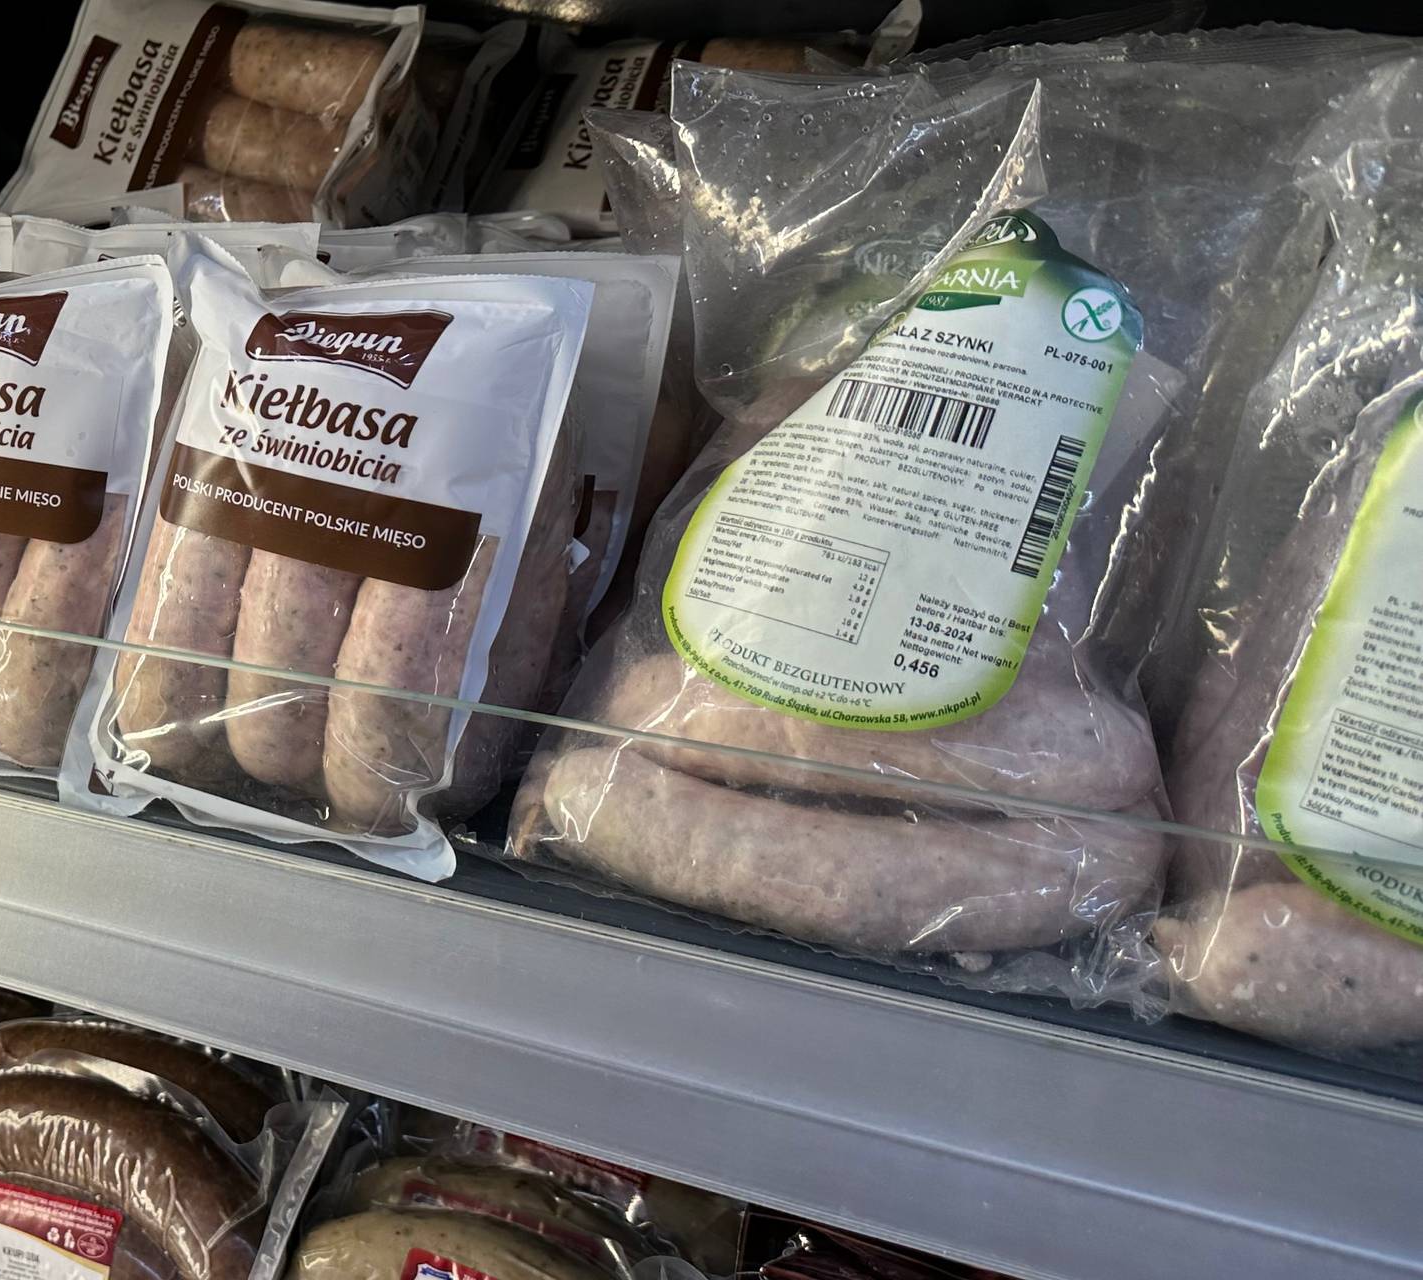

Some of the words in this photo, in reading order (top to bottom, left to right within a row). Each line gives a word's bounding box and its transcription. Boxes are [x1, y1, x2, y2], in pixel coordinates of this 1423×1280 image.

[93, 39, 163, 165] Kiełbasa
[121, 141, 137, 163] ze
[131, 44, 179, 139] świniobicia
[939, 266, 1023, 291] ARNIA
[920, 328, 931, 341] Z
[934, 331, 995, 354] SZYNKI
[1044, 345, 1115, 375] PL-075-001
[901, 359, 950, 377] OCHRONNEJ
[954, 367, 996, 386] PRODUCT
[995, 378, 1032, 396] PACKED
[1049, 394, 1104, 416] PROTECTIVE
[997, 388, 1044, 408] VERPACKT
[220, 369, 419, 450] Kiełbasa
[218, 423, 248, 449] ze
[251, 427, 403, 485] świniobicia
[922, 446, 966, 463] przyprawy
[966, 457, 1008, 475] naturalne,
[1009, 468, 1038, 483] cukier,
[854, 452, 892, 467] PRODUKT
[897, 462, 965, 487] BEZGLUTENOWY.
[992, 488, 1030, 505] otwarciu
[977, 472, 1005, 486] azotyn
[1010, 480, 1033, 494] sodu,
[14, 488, 62, 508] MIĘSO
[172, 472, 213, 498] POLSKI
[214, 486, 304, 522] PRODUCENT
[304, 509, 370, 539] POLSKIE
[371, 524, 427, 551] MIĘSO
[867, 491, 894, 505] natural
[894, 497, 913, 511] pork
[943, 510, 1001, 533] GLUTEN-FREE
[891, 484, 921, 499] natural
[952, 501, 977, 515] sugar,
[928, 518, 970, 537] natürliche
[909, 615, 974, 643] 13-05-2024
[915, 604, 946, 619] before
[952, 615, 988, 632] Haltbar
[988, 625, 1007, 638] bis:
[918, 592, 951, 611] Należy
[952, 603, 987, 619] spożyć
[987, 613, 1001, 625] do
[1007, 619, 1032, 633] Best
[899, 638, 964, 666] Nettogewicht:
[903, 628, 929, 643] Masa
[930, 637, 955, 652] netto
[961, 646, 979, 659] Net
[980, 653, 1013, 670] weight
[773, 660, 907, 695] BEZGLUTENOWY
[893, 653, 941, 679] 0,456
[732, 678, 763, 698] 41-709
[762, 691, 786, 706] Ruda
[785, 699, 819, 717] Śląska,
[819, 708, 892, 725] ul.Chorzowska
[909, 690, 983, 722] www.nikpol.pl
[1333, 724, 1375, 745] Wartość
[1338, 711, 1380, 734] Wartość
[1305, 798, 1344, 820] Sól/Salt
[1311, 786, 1380, 818] Białko/Protein
[1355, 864, 1423, 903] RODUK
